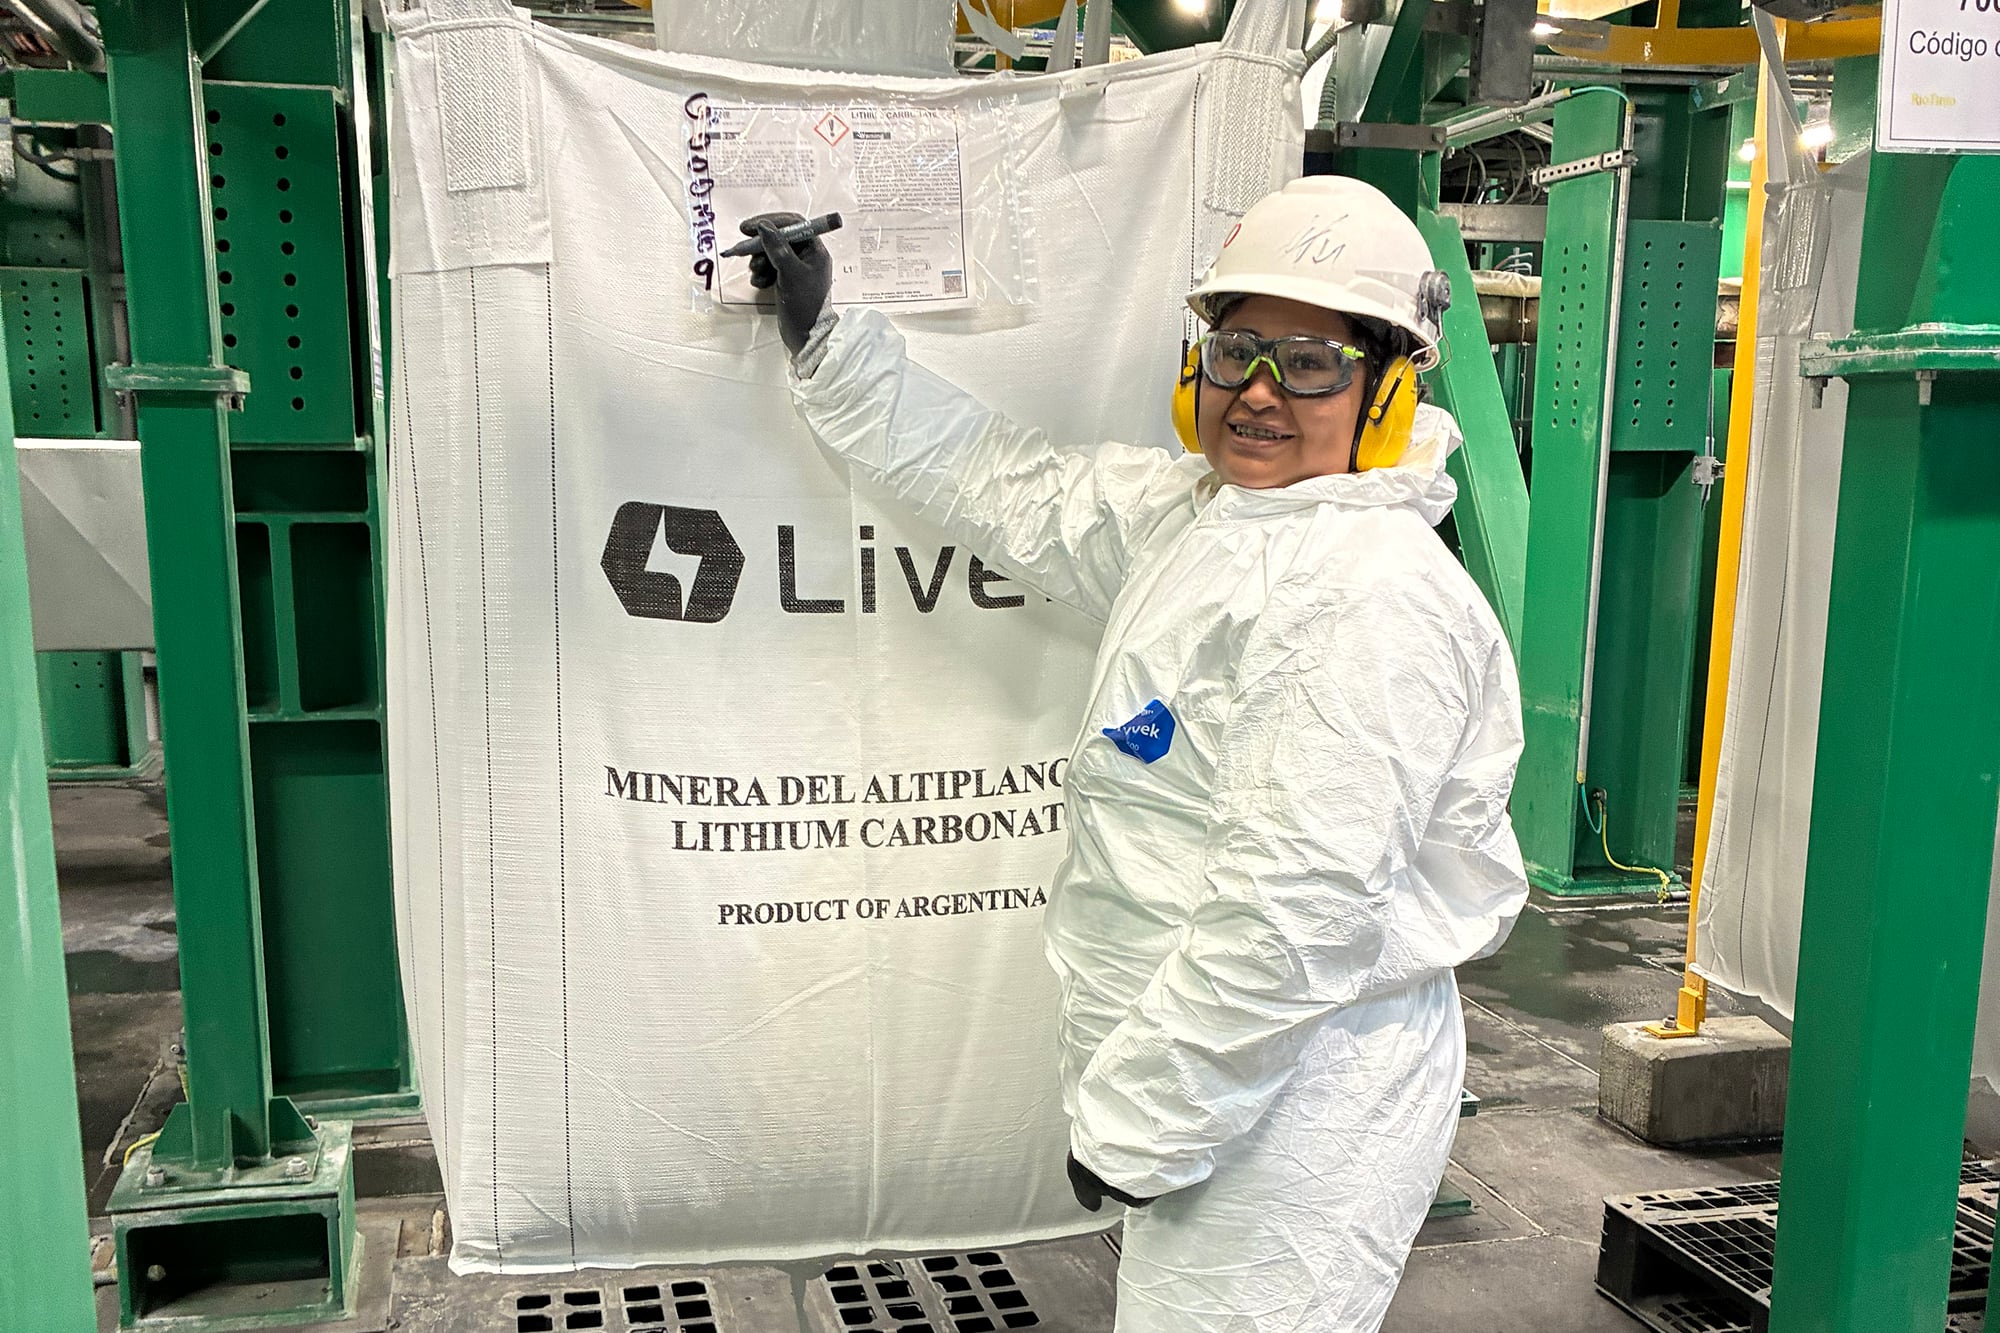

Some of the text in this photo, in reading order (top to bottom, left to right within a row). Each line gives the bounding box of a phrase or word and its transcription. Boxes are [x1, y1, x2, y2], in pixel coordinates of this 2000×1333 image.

[1909, 30, 1988, 62] Código
[851, 111, 938, 120] LITHIU CARBATE
[777, 525, 1051, 614] Live
[1117, 723, 1160, 739] yvek
[604, 765, 771, 807] MINERA
[777, 775, 856, 805] DEL
[671, 802, 1065, 852] LITHIUM CARBONAT
[718, 885, 1048, 925] PRODUCT OF ARGENTINA
